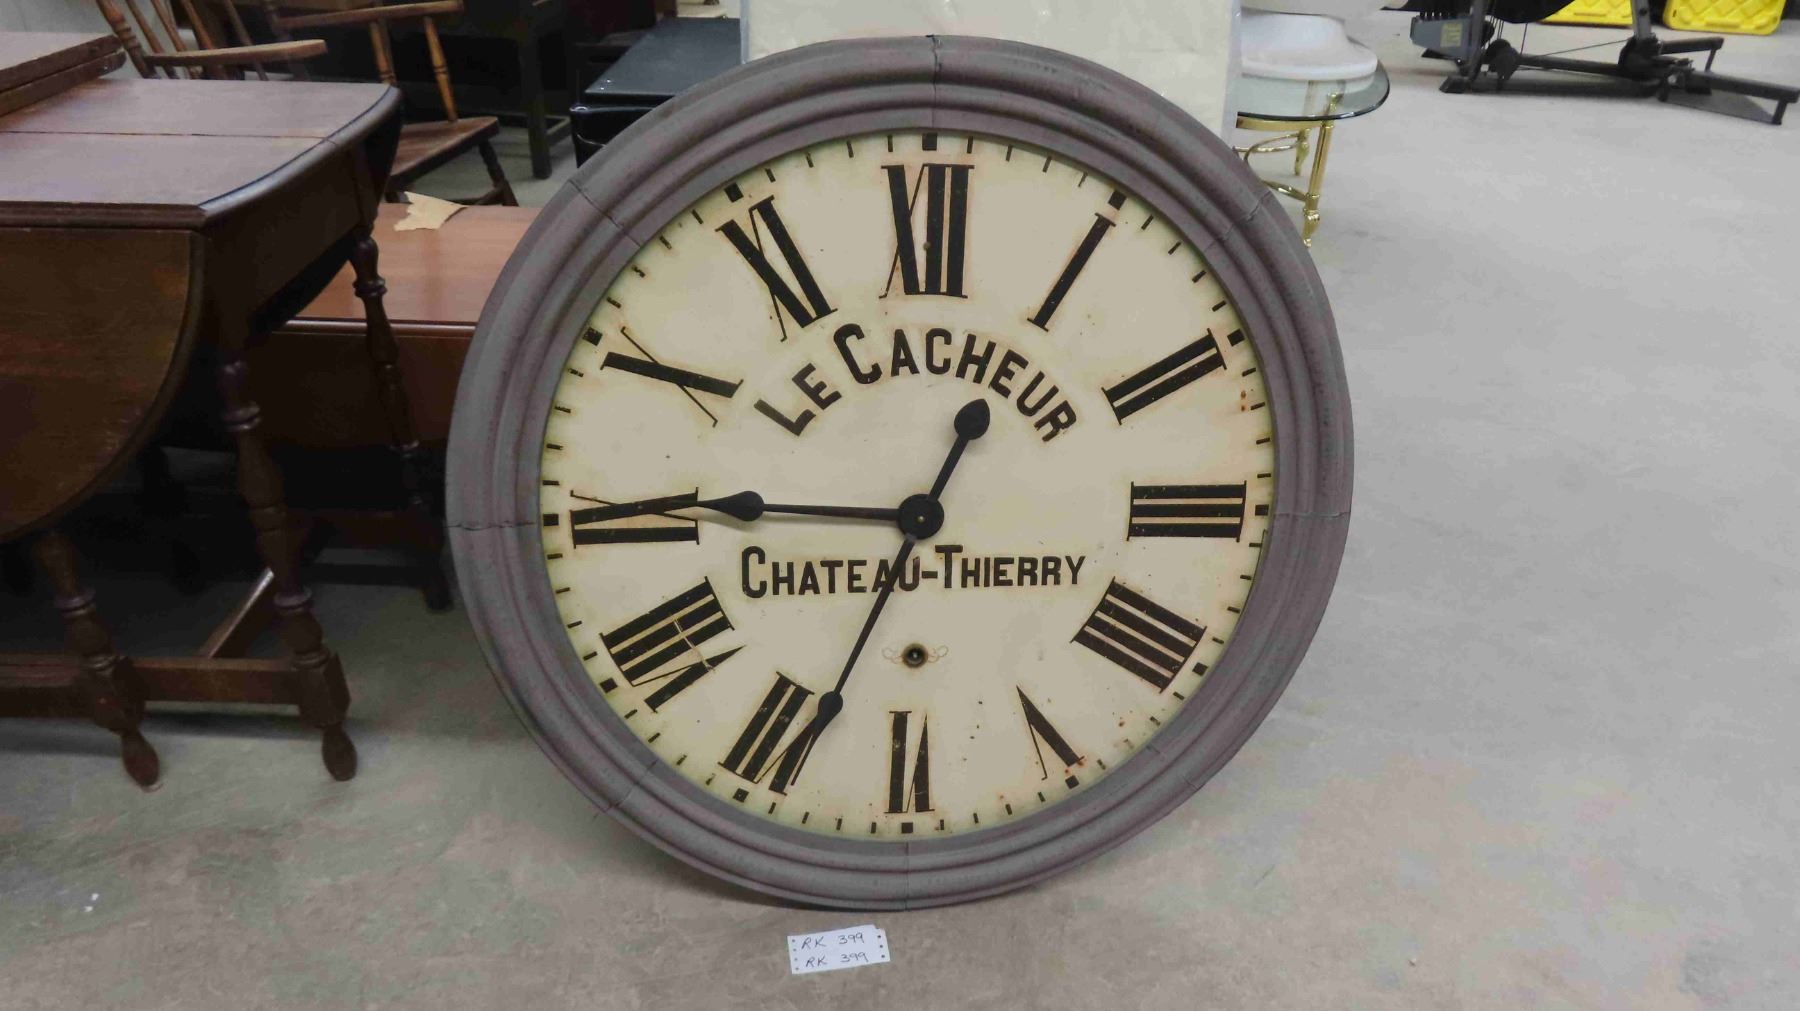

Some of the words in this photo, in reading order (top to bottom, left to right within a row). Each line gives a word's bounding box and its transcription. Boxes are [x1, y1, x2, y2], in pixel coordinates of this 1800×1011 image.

[715, 195, 838, 342] XI
[879, 163, 975, 298] XII
[600, 326, 743, 428] X
[833, 323, 1077, 442] CACHEUR
[1101, 328, 1227, 425] II
[1126, 480, 1246, 542] III
[1016, 685, 1085, 781] V
[801, 936, 827, 950] RK
[838, 932, 865, 945] 399
[805, 955, 828, 968] RK
[840, 951, 869, 963] 399
